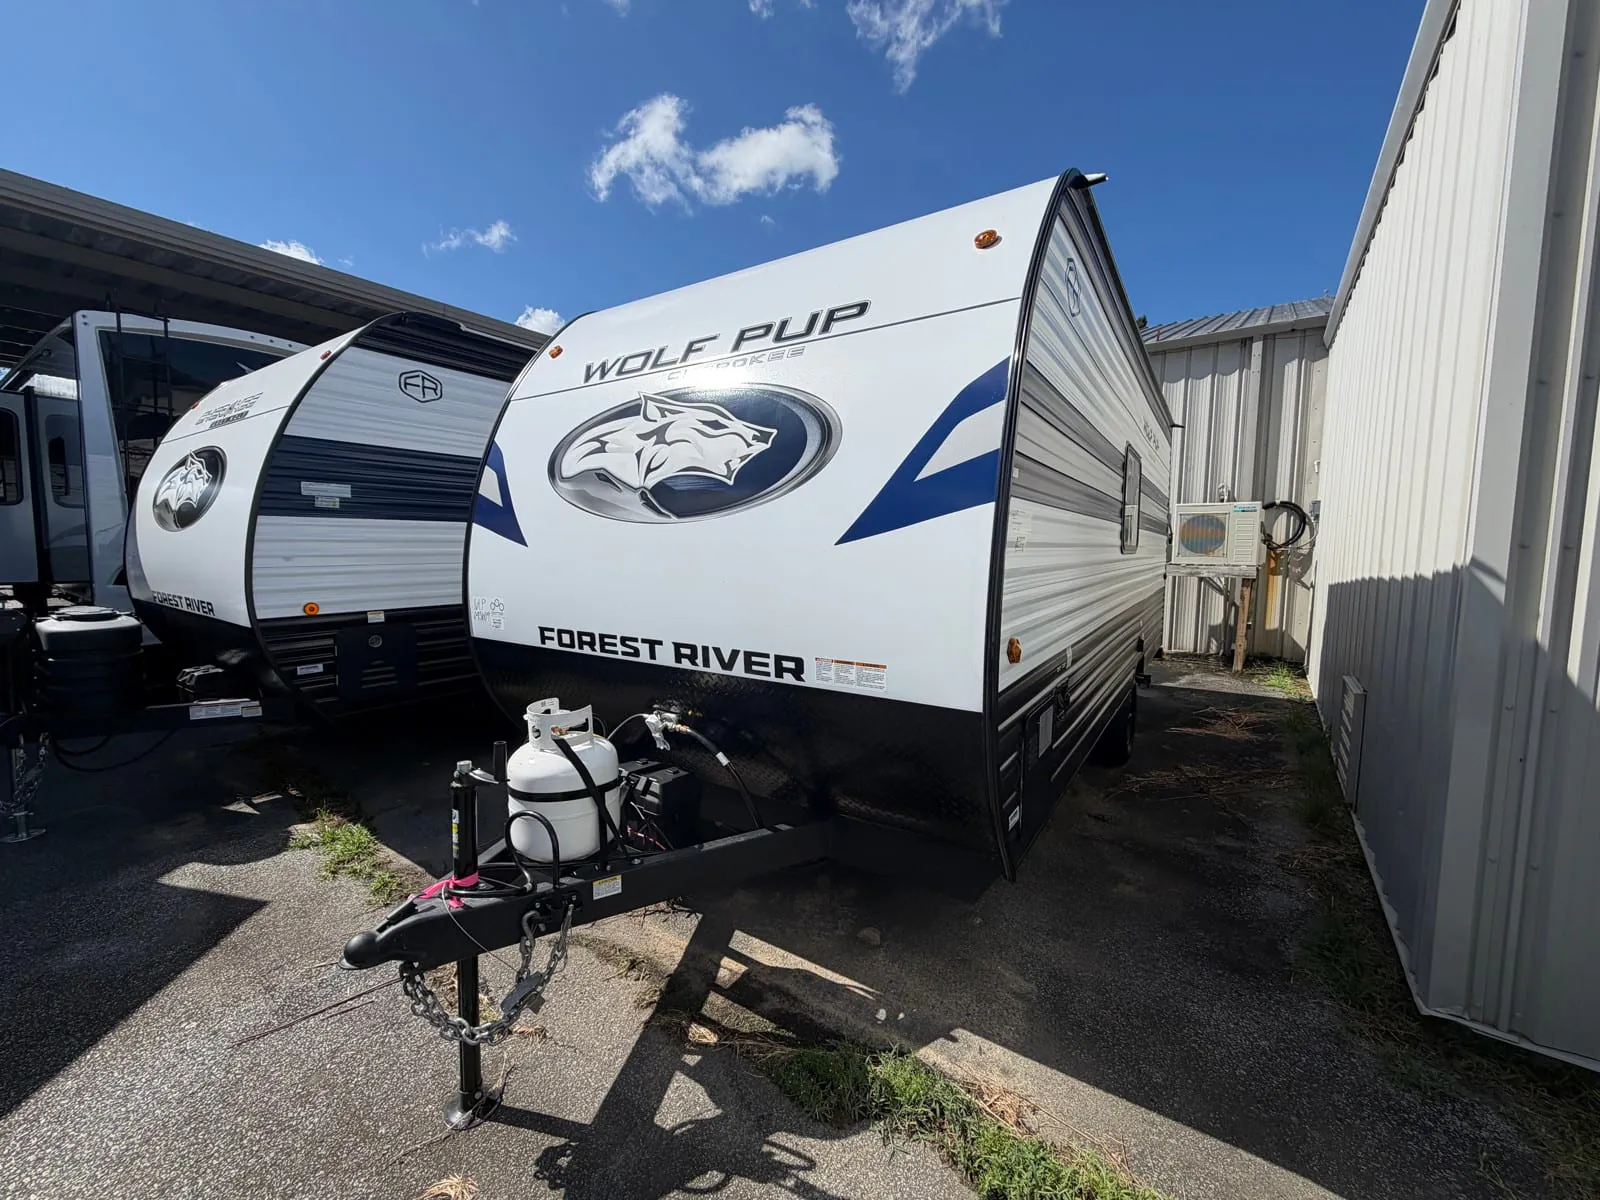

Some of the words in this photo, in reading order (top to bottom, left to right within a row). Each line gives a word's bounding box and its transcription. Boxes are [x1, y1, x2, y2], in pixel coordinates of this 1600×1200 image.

[583, 333, 720, 383] WOLF
[730, 299, 872, 353] PUP
[151, 591, 184, 608] FOREST
[184, 596, 216, 616] RIVER
[538, 626, 663, 660] FOREST
[672, 641, 806, 682] RIVER
